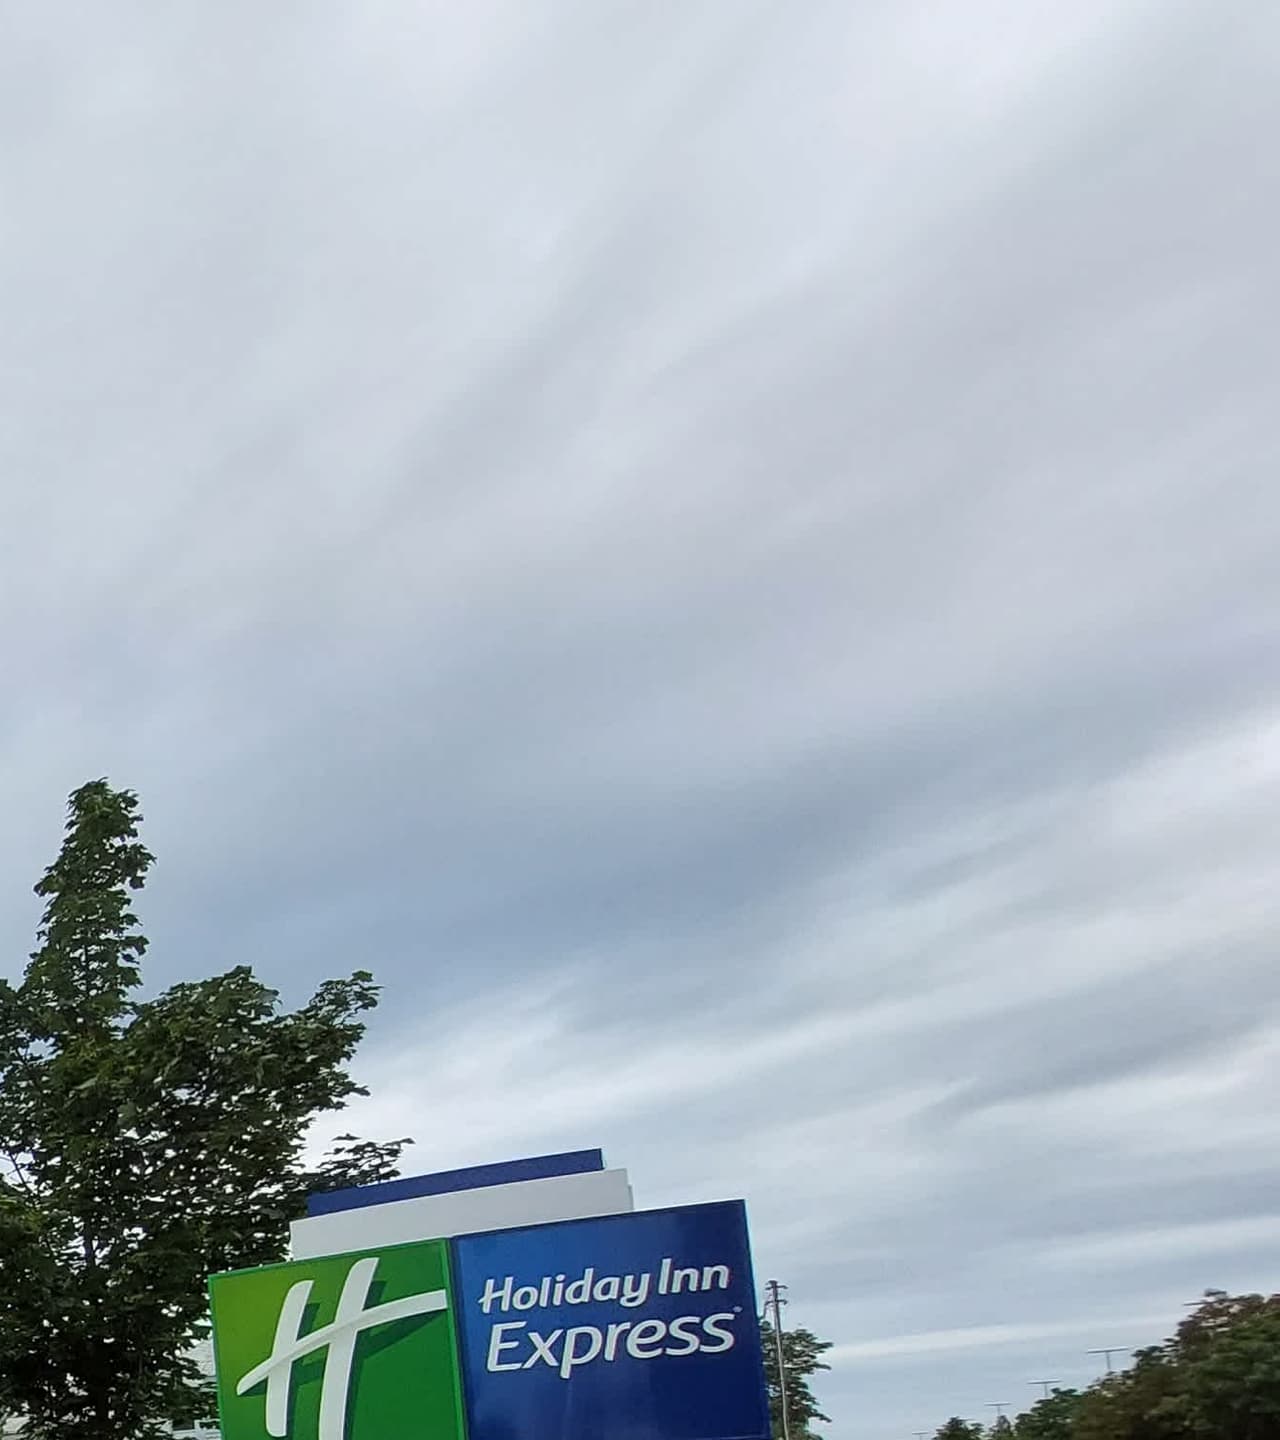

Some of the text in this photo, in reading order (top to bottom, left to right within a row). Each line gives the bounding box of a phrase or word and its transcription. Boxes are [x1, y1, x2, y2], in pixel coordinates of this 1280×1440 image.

[478, 1258, 730, 1314] Holiday Inn
[487, 1313, 735, 1379] Express
